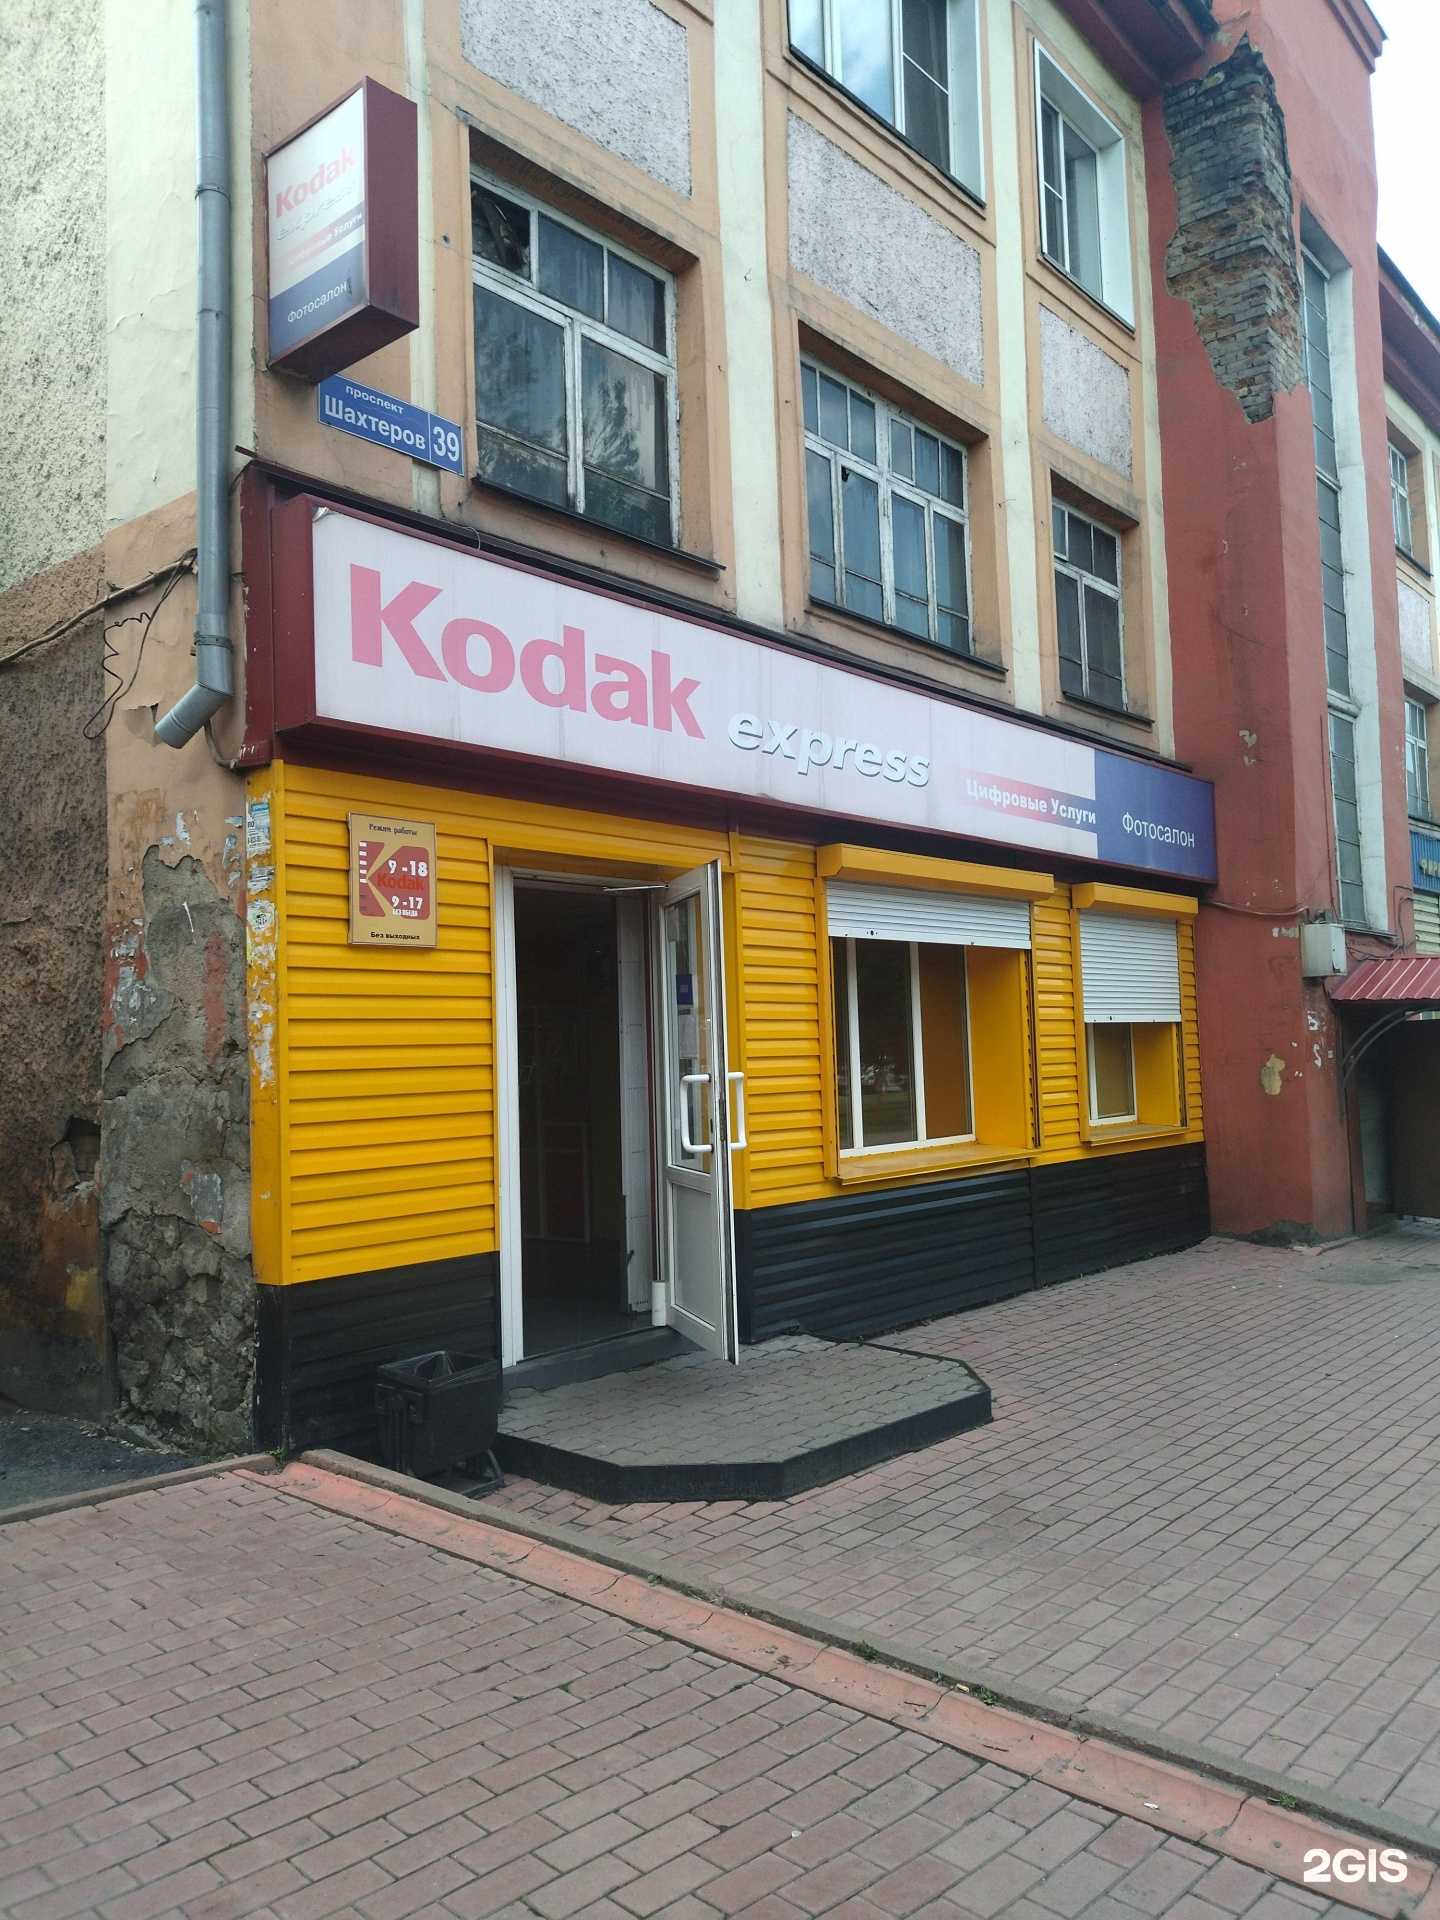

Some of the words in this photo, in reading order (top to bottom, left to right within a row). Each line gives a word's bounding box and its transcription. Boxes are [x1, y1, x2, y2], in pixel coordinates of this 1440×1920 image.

[275, 145, 356, 219] Kodak
[287, 280, 348, 323] Фотосалон
[345, 385, 404, 414] проспект
[324, 394, 426, 450] Шахтеров
[433, 426, 460, 462] 39
[350, 563, 705, 740] Kodak
[728, 711, 931, 788] express
[965, 778, 1048, 814] Цифровые
[1051, 798, 1097, 826] Услуги
[1121, 811, 1196, 849] Фотосалон
[370, 931, 384, 939] Без
